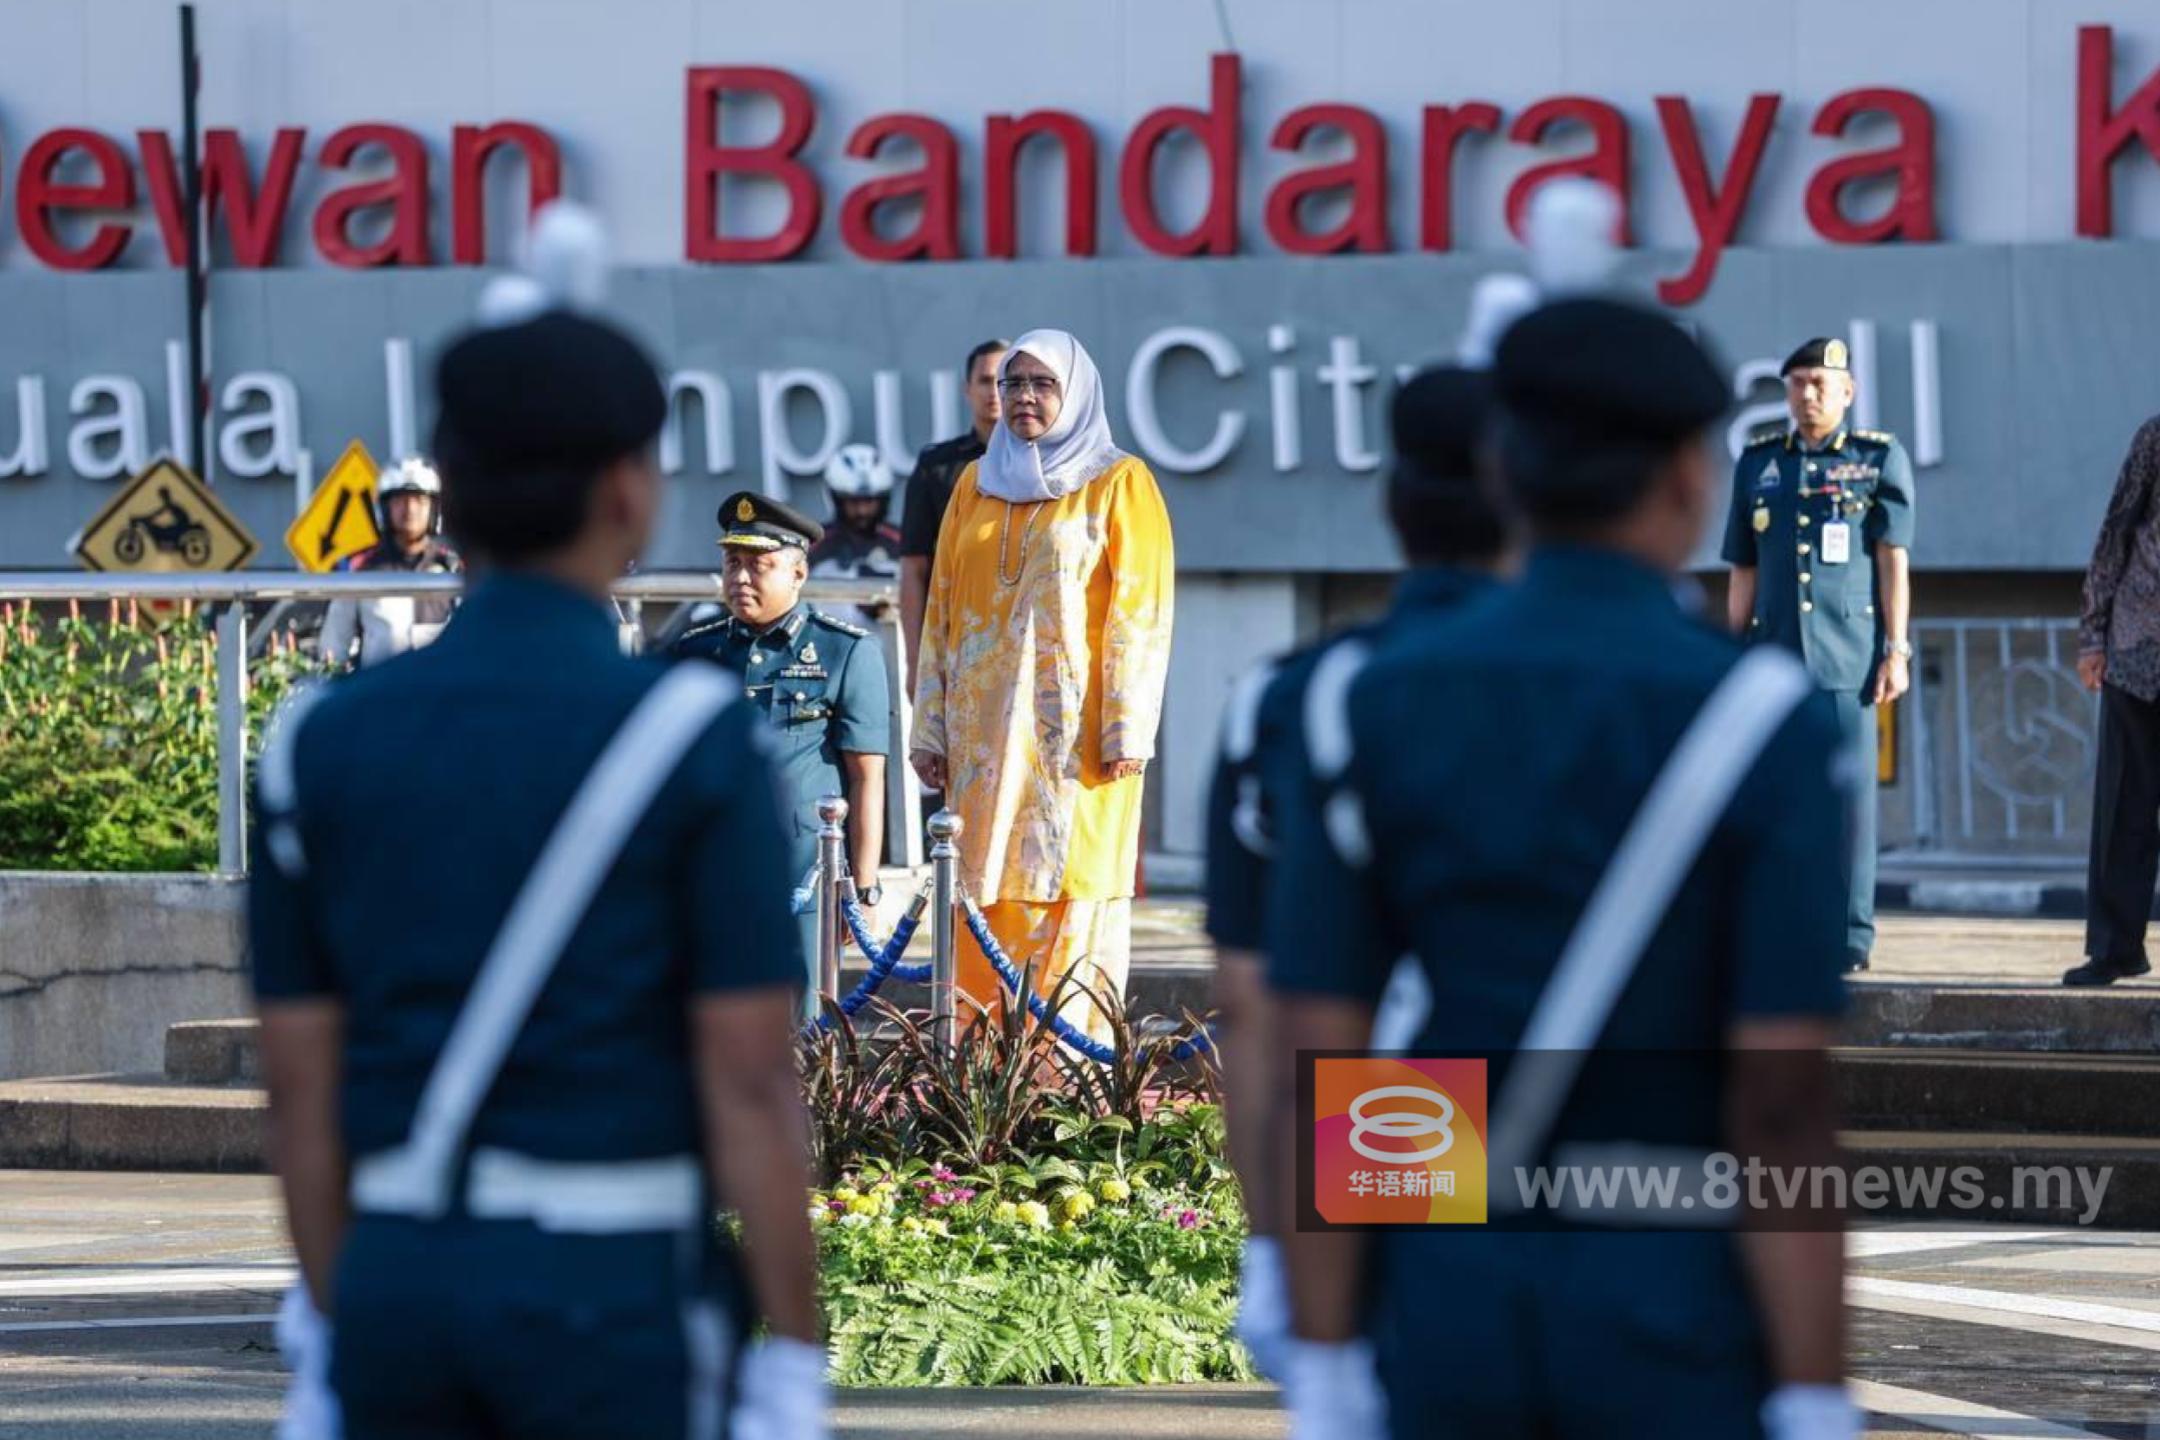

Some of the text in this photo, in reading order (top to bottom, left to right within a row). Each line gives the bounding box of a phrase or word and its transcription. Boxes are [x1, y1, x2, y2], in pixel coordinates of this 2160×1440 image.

[0, 23, 2160, 308] ewan Bandaraya K
[1126, 324, 1416, 473] Cit
[1688, 319, 1942, 467] all
